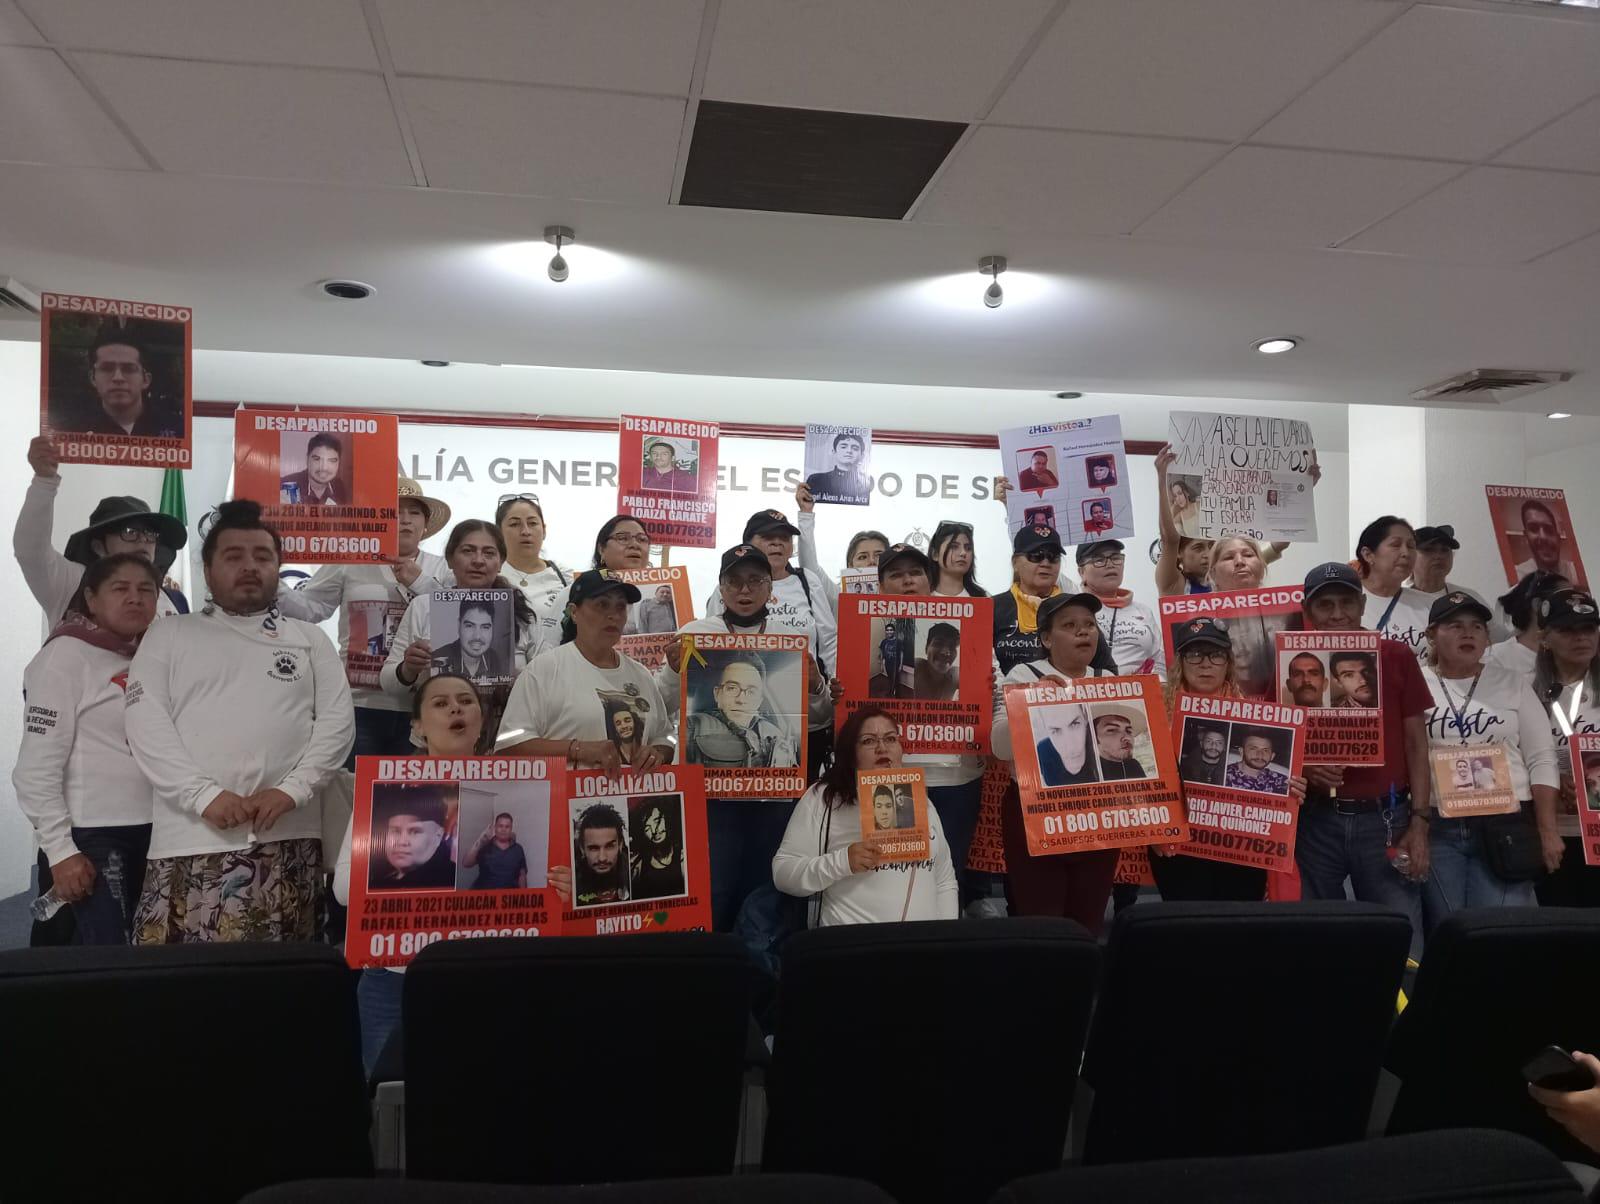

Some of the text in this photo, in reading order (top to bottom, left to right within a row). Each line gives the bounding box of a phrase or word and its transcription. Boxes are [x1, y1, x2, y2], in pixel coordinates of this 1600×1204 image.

[43, 294, 191, 322] DESAPARECIDO
[254, 416, 378, 433] DESAPARECIDO
[625, 418, 719, 438] DESAPARECIDO
[809, 425, 868, 436] DESAPARECIDO
[1169, 415, 1224, 446] VIVA
[57, 442, 190, 463] 18006703600
[151, 439, 183, 449] CRUZ
[1231, 447, 1309, 473] QUEREMOS
[398, 448, 475, 483] LÍA
[487, 457, 618, 488] GENER
[915, 473, 960, 501] DE
[1486, 486, 1564, 500] DESAPARECIDO
[622, 496, 656, 509] PABLO
[658, 499, 716, 513] FRANCISCO
[309, 507, 320, 517] EL
[379, 508, 398, 520] SIN.
[631, 508, 708, 523] LOAIZA GARATE
[361, 523, 388, 533] VALDEZ
[309, 537, 381, 553] 6703600
[434, 591, 509, 601] DESAPARECIDO
[1162, 591, 1304, 615] DESAPARECIDO
[858, 600, 974, 618] DESAPARECIDO
[694, 635, 807, 650] ESAPARECIDO
[1284, 635, 1378, 649] DESAPARECIDO
[1024, 681, 1144, 704] DESAPARECIDO
[1181, 696, 1304, 725] DESAPARECIDO
[1317, 718, 1379, 728] GUADALUPE
[1425, 707, 1504, 739] Hasta
[906, 725, 975, 742] 6703600
[1338, 731, 1380, 740] GUICHO
[1435, 749, 1502, 761] DESAPARECIDO
[379, 759, 547, 781] DESAPARECIDO
[734, 769, 770, 778] GARCIA
[771, 769, 799, 778] CRUZ
[575, 772, 676, 798] LOCALIZADO
[861, 773, 921, 785] DESAPARECIDO
[1034, 791, 1047, 802] 19
[1045, 785, 1092, 801] NOVIEMBRE
[1027, 803, 1057, 815] MIGUEL
[1058, 799, 1093, 812] ENRIQUE
[1208, 801, 1243, 820] JAVIER
[1243, 806, 1292, 826] CANDIDO
[1044, 805, 1170, 835] 01 800 6703600
[1188, 811, 1218, 828] OJEDA
[1050, 836, 1095, 848] SABUESOS
[364, 899, 378, 914] 23
[380, 898, 413, 913] ABRIL
[415, 898, 443, 913] 2021
[501, 894, 545, 910] SINALOA
[361, 917, 409, 931] RAFAEL
[494, 910, 549, 926] NIEBLAS
[596, 914, 642, 935] RAYITO
[370, 933, 395, 957] 01
